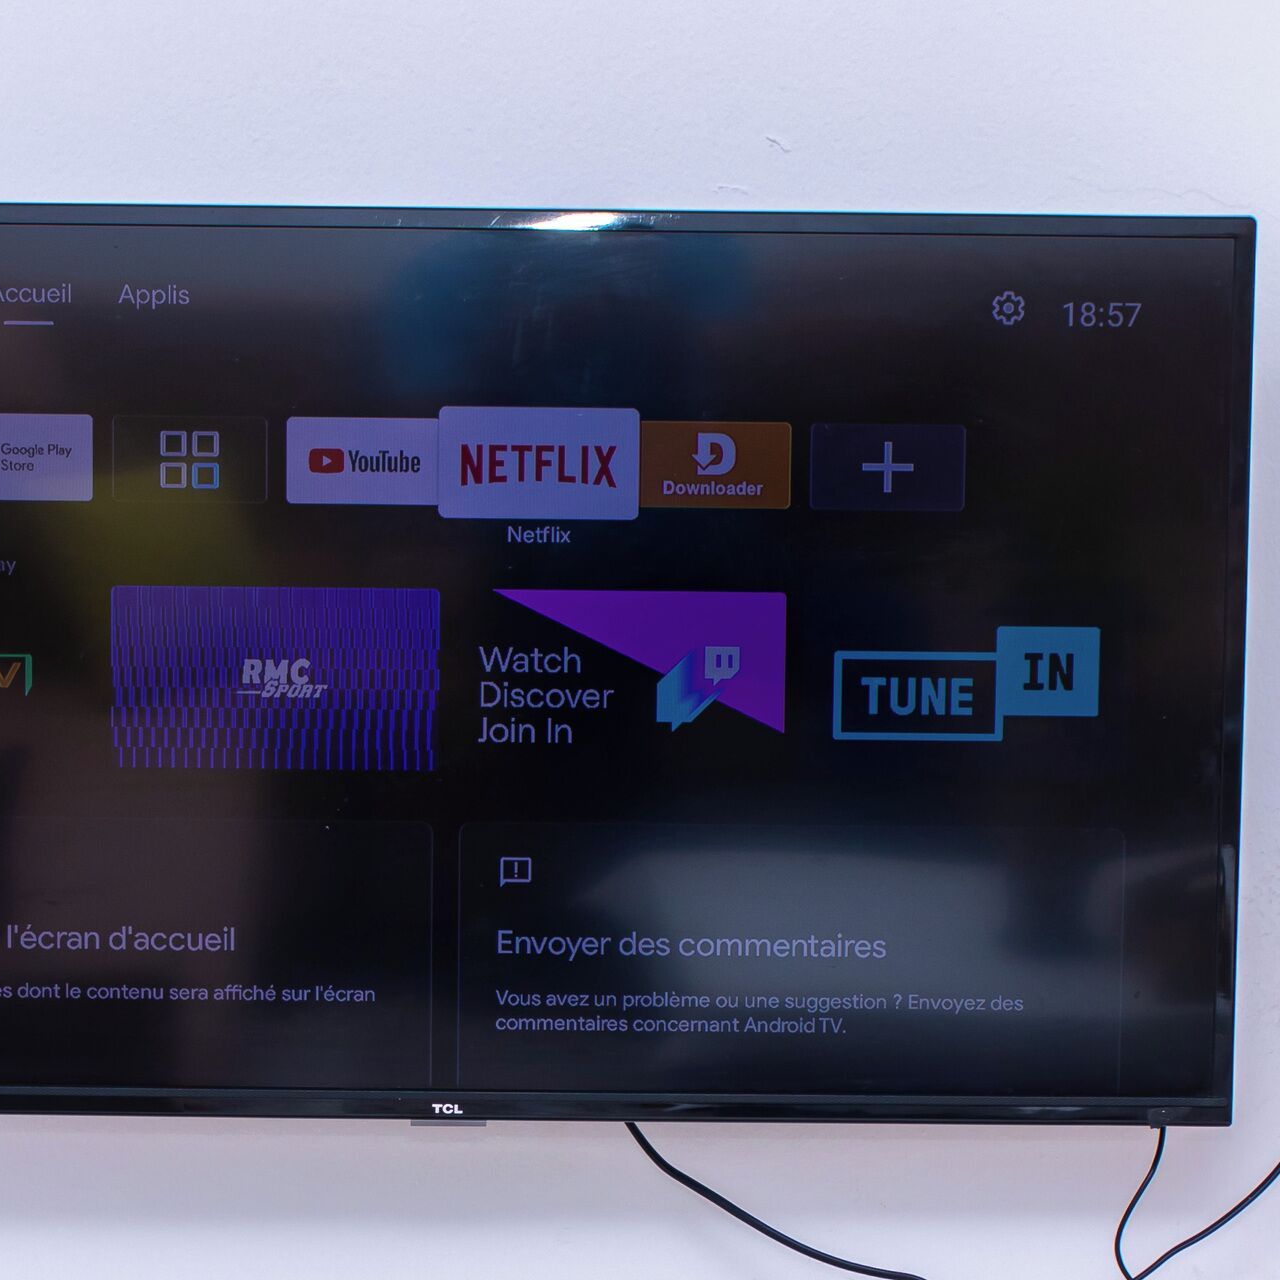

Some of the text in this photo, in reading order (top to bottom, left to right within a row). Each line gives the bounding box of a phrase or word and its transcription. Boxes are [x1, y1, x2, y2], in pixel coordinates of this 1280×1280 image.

[118, 284, 190, 309] Applis
[1062, 302, 1143, 328] 18:57
[0, 443, 72, 459] Google Play
[348, 449, 421, 473] YouTube
[0, 459, 34, 471] Store
[460, 443, 618, 489] NETFLIX
[662, 480, 764, 497] Downloader
[507, 525, 571, 544] Netflix
[242, 658, 312, 685] RMC
[479, 646, 582, 674] Watch
[261, 680, 328, 698] SPORT
[479, 681, 615, 710] Discover
[860, 652, 1074, 716] TUNE IN
[478, 718, 573, 744] Join In
[7, 924, 100, 950] l'écran
[108, 926, 237, 952] d'accueil
[496, 930, 887, 962] Envoyer des commentaires
[17, 981, 61, 1000] dont
[65, 982, 81, 1000] le
[86, 984, 164, 1001] contenu
[169, 987, 209, 1001] sera
[213, 982, 276, 1002] affiché
[281, 987, 311, 1002] sur
[315, 984, 376, 1003] l'écran
[496, 990, 1024, 1014] Vous avez un problème ou une suggestion ? Envoyez des
[495, 1015, 847, 1034] commentaires concernant Android TV.
[432, 1103, 463, 1115] TCL
